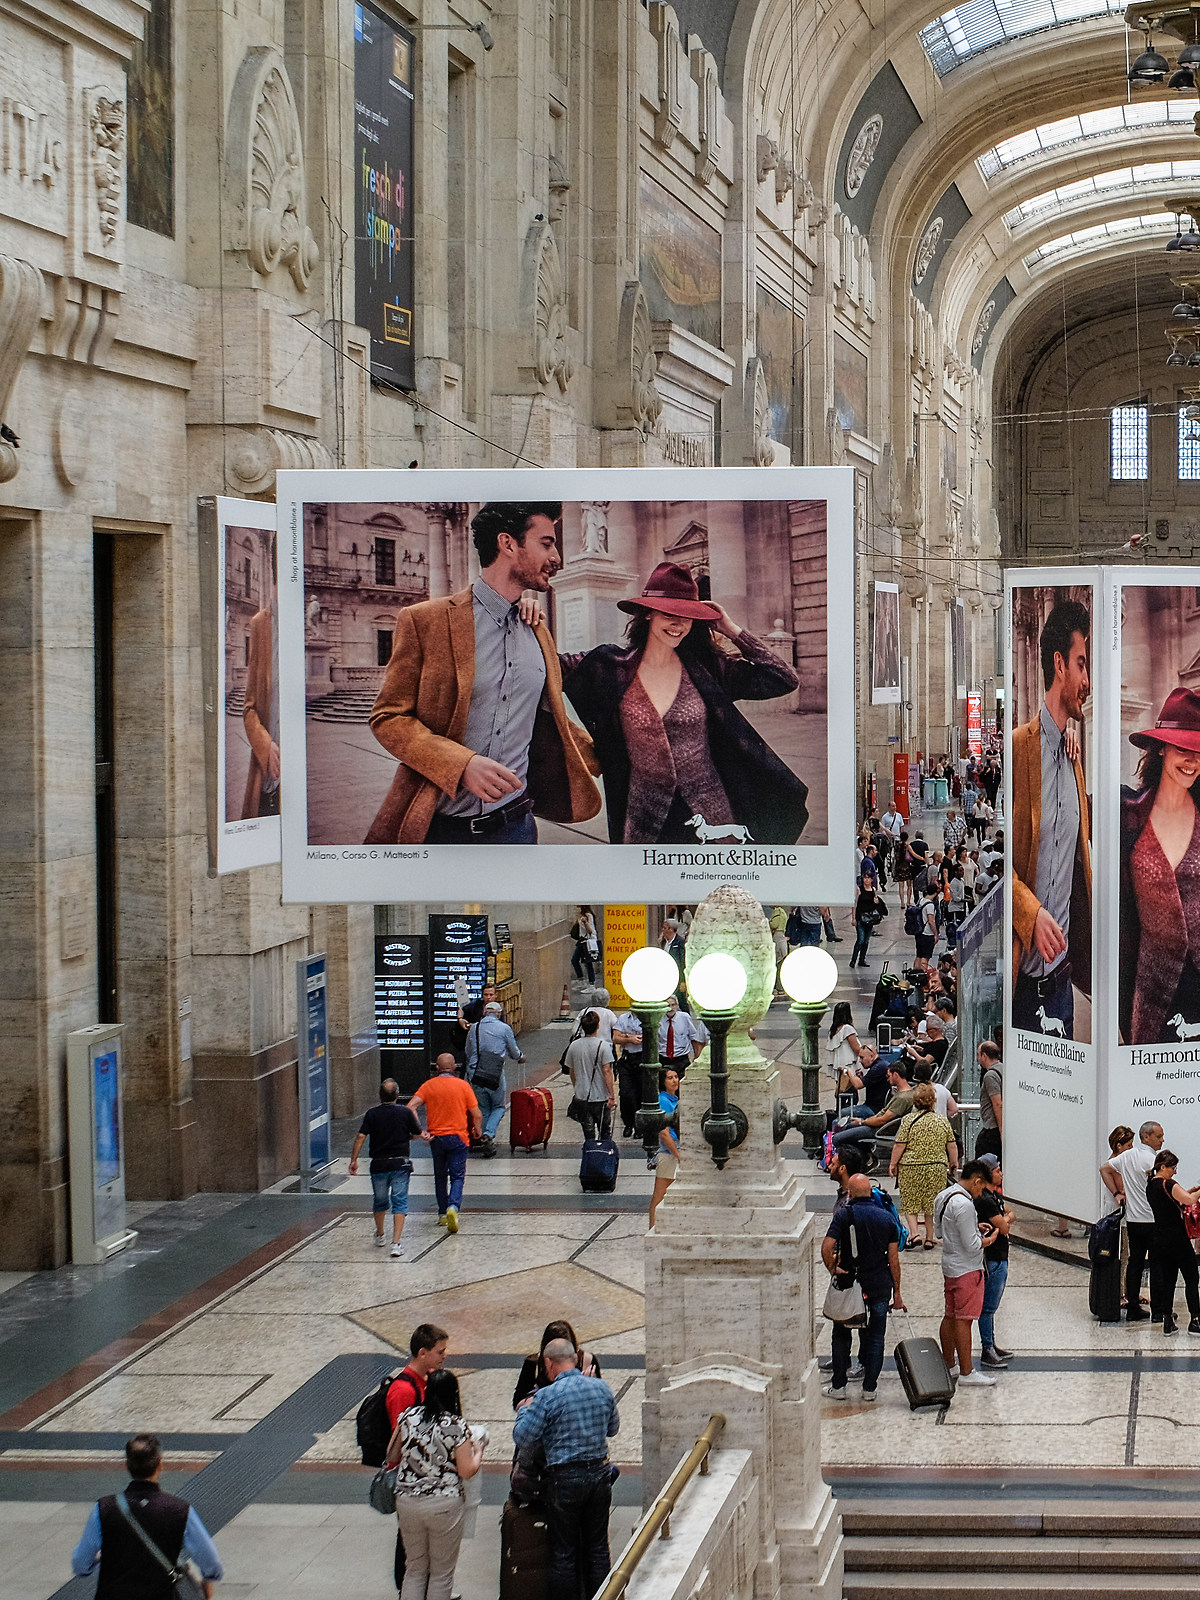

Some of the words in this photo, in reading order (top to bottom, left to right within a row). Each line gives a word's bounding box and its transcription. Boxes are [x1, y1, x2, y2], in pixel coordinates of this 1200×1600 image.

[291, 565, 299, 583] Shop
[306, 851, 340, 862] Milano,
[342, 851, 368, 860] Corso
[370, 851, 380, 860] G.
[383, 851, 420, 860] Matteotti
[422, 851, 429, 860] 5
[680, 871, 760, 881] #mediterraneanlife
[606, 909, 645, 917] TABACCHI
[606, 923, 645, 931] DOLCIUMI
[1030, 1058, 1073, 1077] #mediterraneanlife
[1018, 1081, 1035, 1094] Milano,
[1036, 1084, 1050, 1098] Corso
[1058, 1090, 1079, 1104] Matteotti
[1132, 1097, 1167, 1108] Milano,
[1169, 1095, 1195, 1106] Corso
